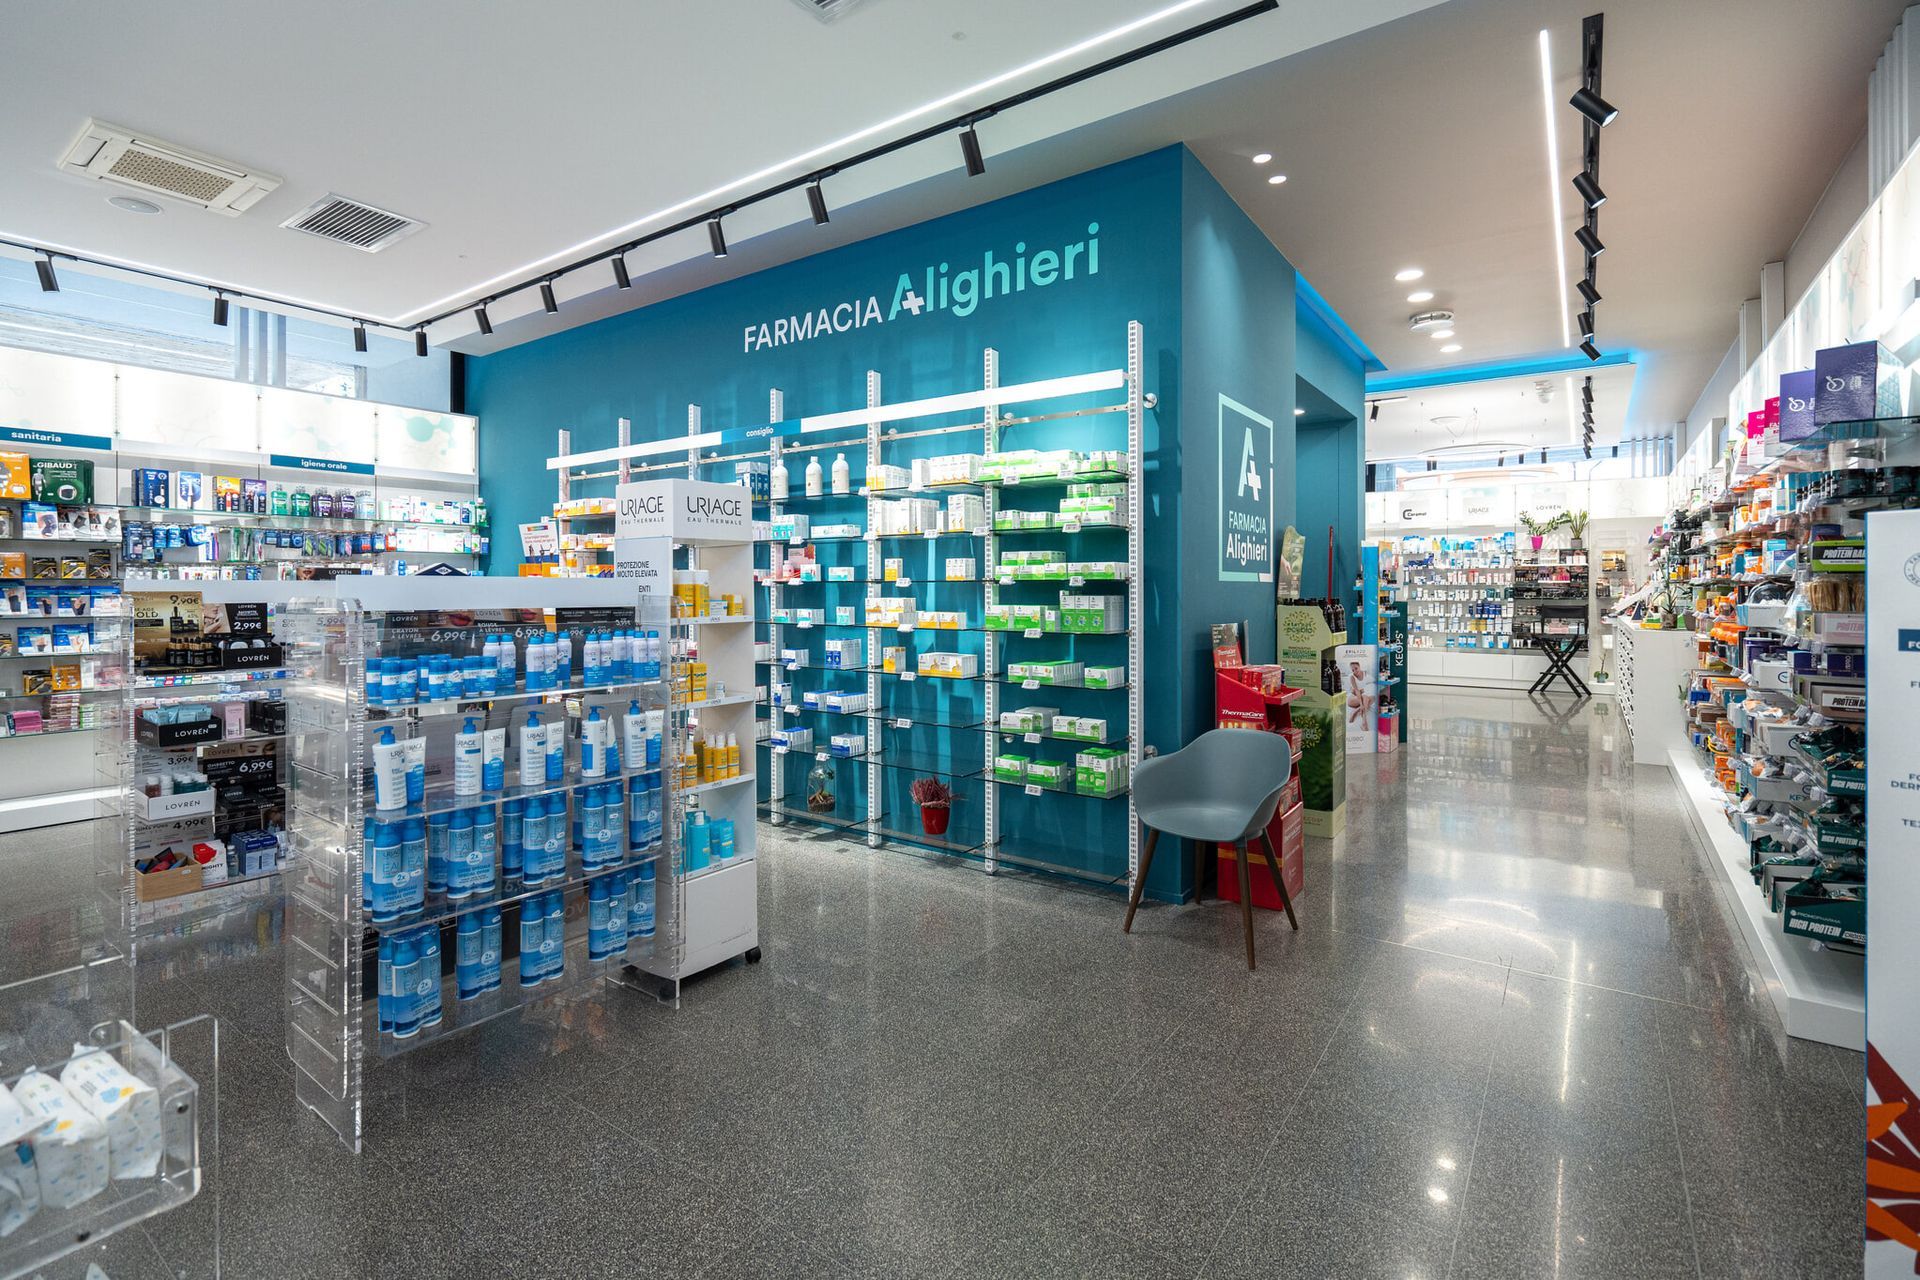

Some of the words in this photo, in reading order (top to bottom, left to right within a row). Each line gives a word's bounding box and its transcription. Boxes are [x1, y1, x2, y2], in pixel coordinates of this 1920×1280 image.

[744, 296, 883, 353] FARMACIA
[888, 222, 1100, 321] Alighieri
[11, 431, 62, 443] sanitaria
[746, 427, 774, 438] consiglio
[37, 461, 73, 469] GIBAUD
[301, 458, 325, 470] igiene
[326, 461, 348, 471] orale
[621, 496, 664, 518] URIAGE
[687, 496, 742, 517] URIAGE
[633, 516, 665, 525] THERMALE
[1229, 511, 1267, 534] FARMACIA
[1226, 533, 1267, 566] Alighieri
[1823, 549, 1852, 559] PROTEIN
[617, 561, 650, 569] PROTEZIONE
[635, 569, 658, 578] ELEVATA
[169, 594, 199, 606] 9,90€
[233, 621, 262, 631] 2,99€
[431, 630, 467, 643] 6,99€
[515, 627, 545, 639] 6,99€
[1832, 697, 1859, 707] PROTEIN
[1221, 708, 1265, 719] ThermaCare
[167, 755, 194, 766] 3,99€
[239, 760, 274, 773] 6,99€
[172, 817, 207, 831] 4,99€
[1835, 836, 1858, 846] PROTEIN
[1789, 918, 1809, 930] HIGH
[1808, 922, 1842, 937] PROTEIN
